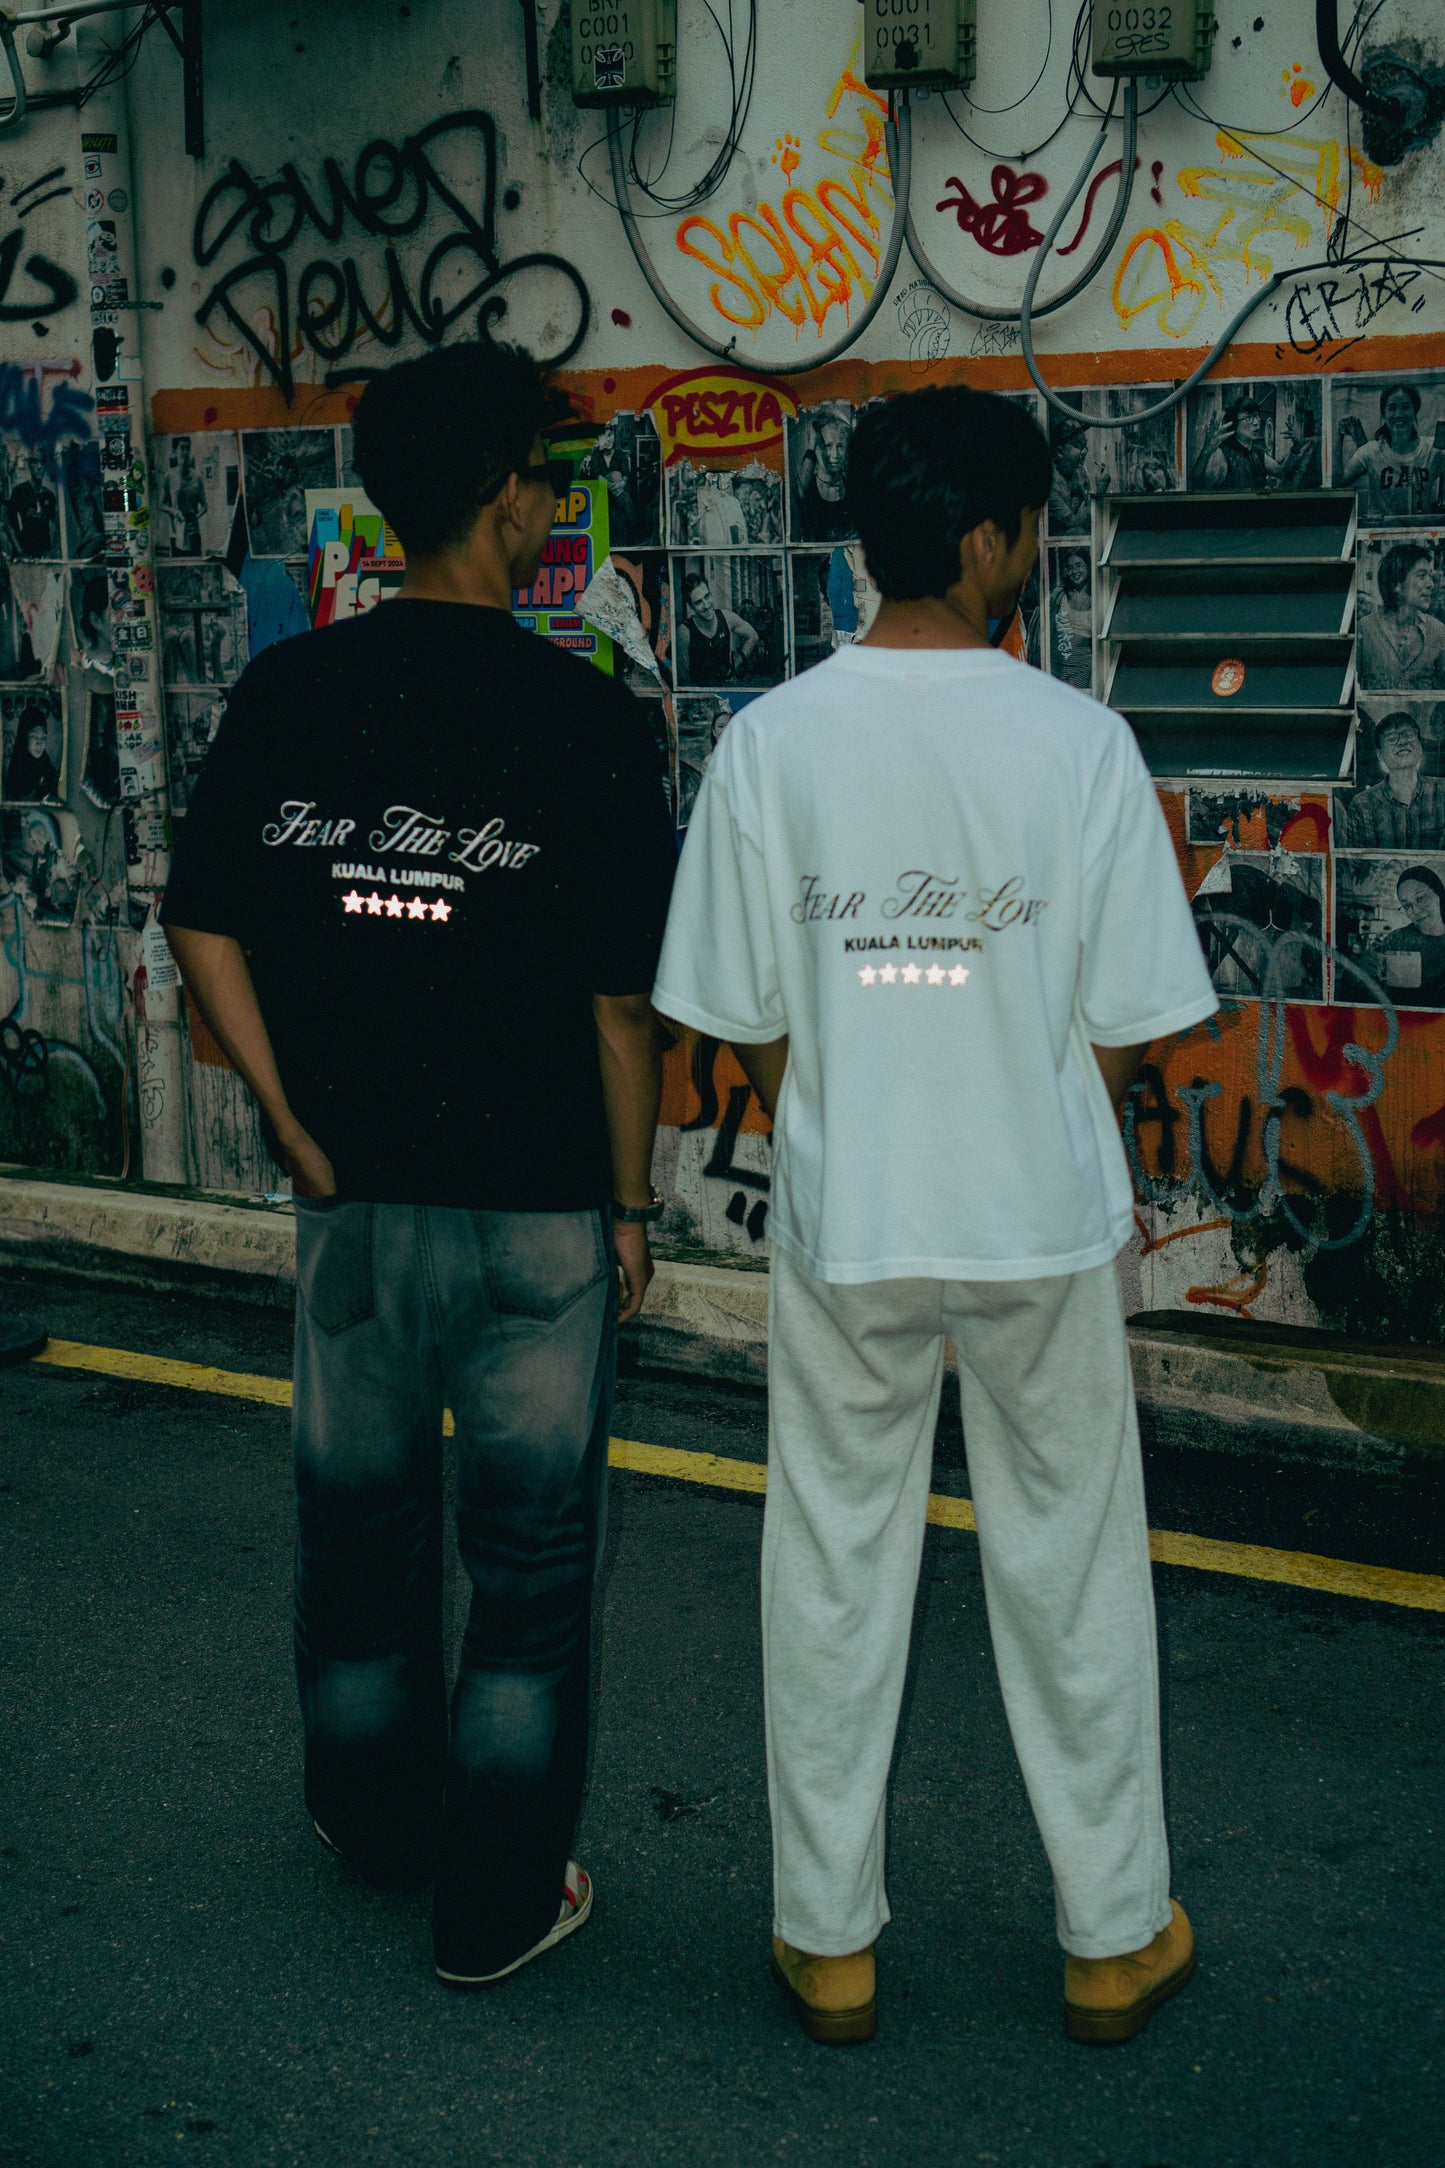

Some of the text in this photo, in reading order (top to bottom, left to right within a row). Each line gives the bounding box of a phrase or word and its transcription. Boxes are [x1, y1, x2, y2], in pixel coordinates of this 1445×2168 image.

[579, 13, 629, 38] C001
[1108, 7, 1172, 30] 0032
[876, 23, 930, 48] 0031
[1380, 466, 1430, 490] GAP
[553, 491, 587, 524] AP
[550, 637, 593, 649] GROUND
[262, 800, 541, 873] FEAR THE LOVE
[331, 863, 465, 892] KUALA LUMPUR
[790, 874, 866, 925] FEAR
[881, 870, 967, 920] THE
[844, 935, 984, 953] KUALA LUMPUR
